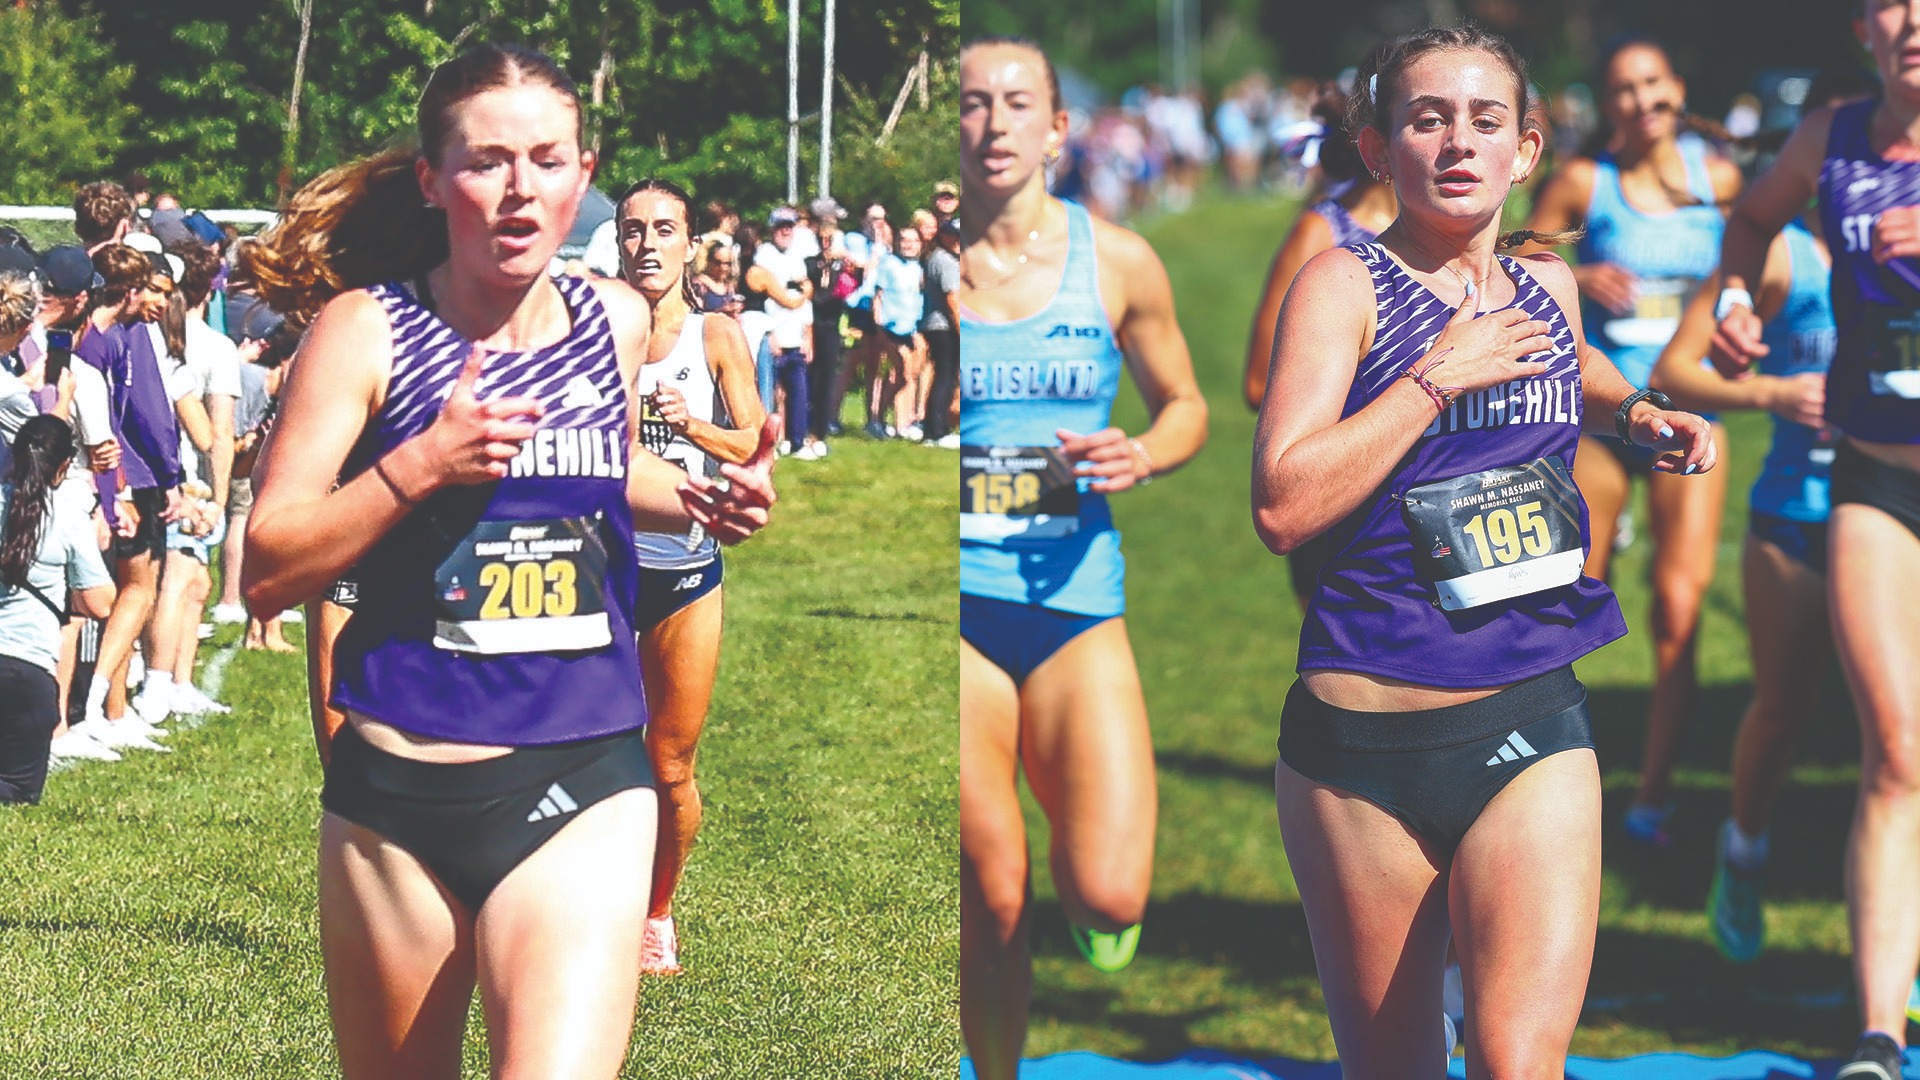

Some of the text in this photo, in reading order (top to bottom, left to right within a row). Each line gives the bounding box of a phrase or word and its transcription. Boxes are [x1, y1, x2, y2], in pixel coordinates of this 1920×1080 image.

[960, 361, 1099, 399] E ISLAND
[511, 428, 625, 479] NEHILL
[966, 472, 1040, 514] 158
[1450, 479, 1545, 509] SHAWN M. NASSANEY
[1480, 501, 1508, 510] MEMORIAL
[1463, 501, 1552, 568] 195
[479, 560, 577, 620] 203
